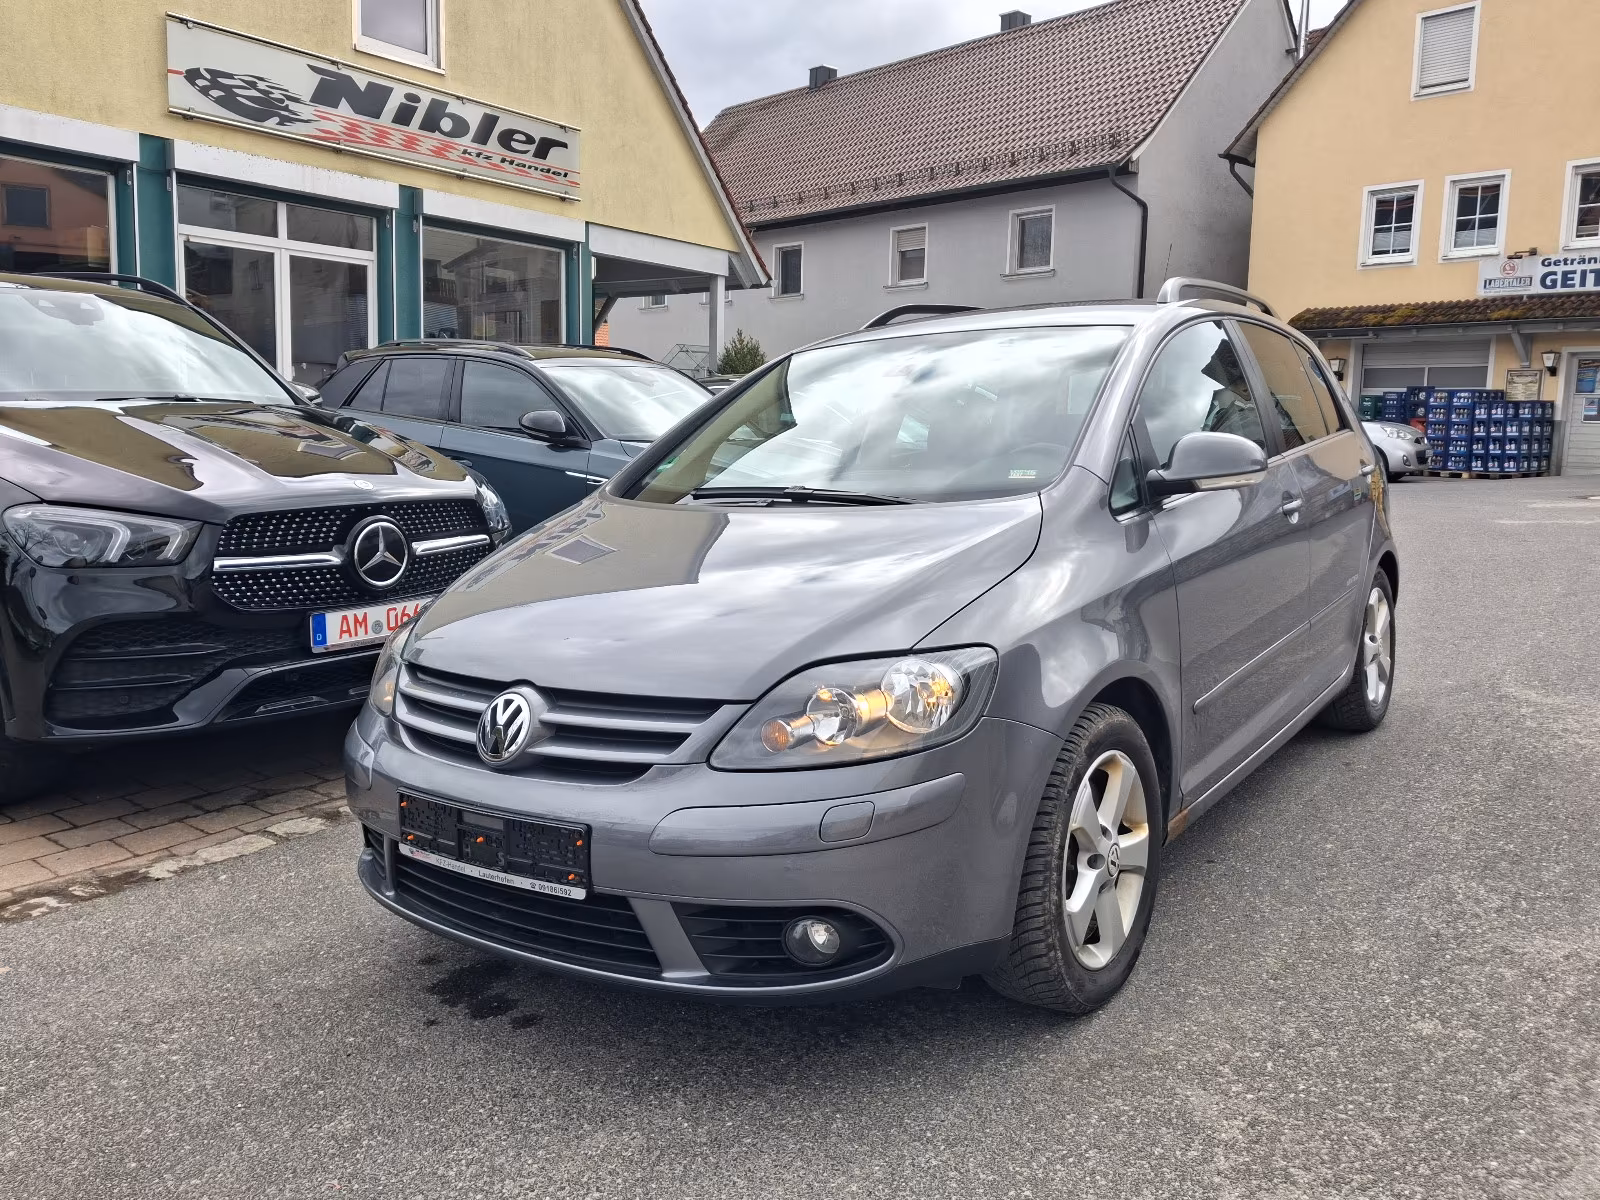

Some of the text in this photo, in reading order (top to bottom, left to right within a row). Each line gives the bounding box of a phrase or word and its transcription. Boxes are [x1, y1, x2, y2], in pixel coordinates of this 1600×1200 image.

[307, 64, 569, 161] Nibler
[461, 148, 568, 178] kfz Handel
[1541, 255, 1600, 267] Geträn
[1486, 277, 1531, 289] LABERTALER
[339, 611, 369, 640] AM
[316, 633, 322, 641] D
[478, 870, 515, 885] Lauterhofen
